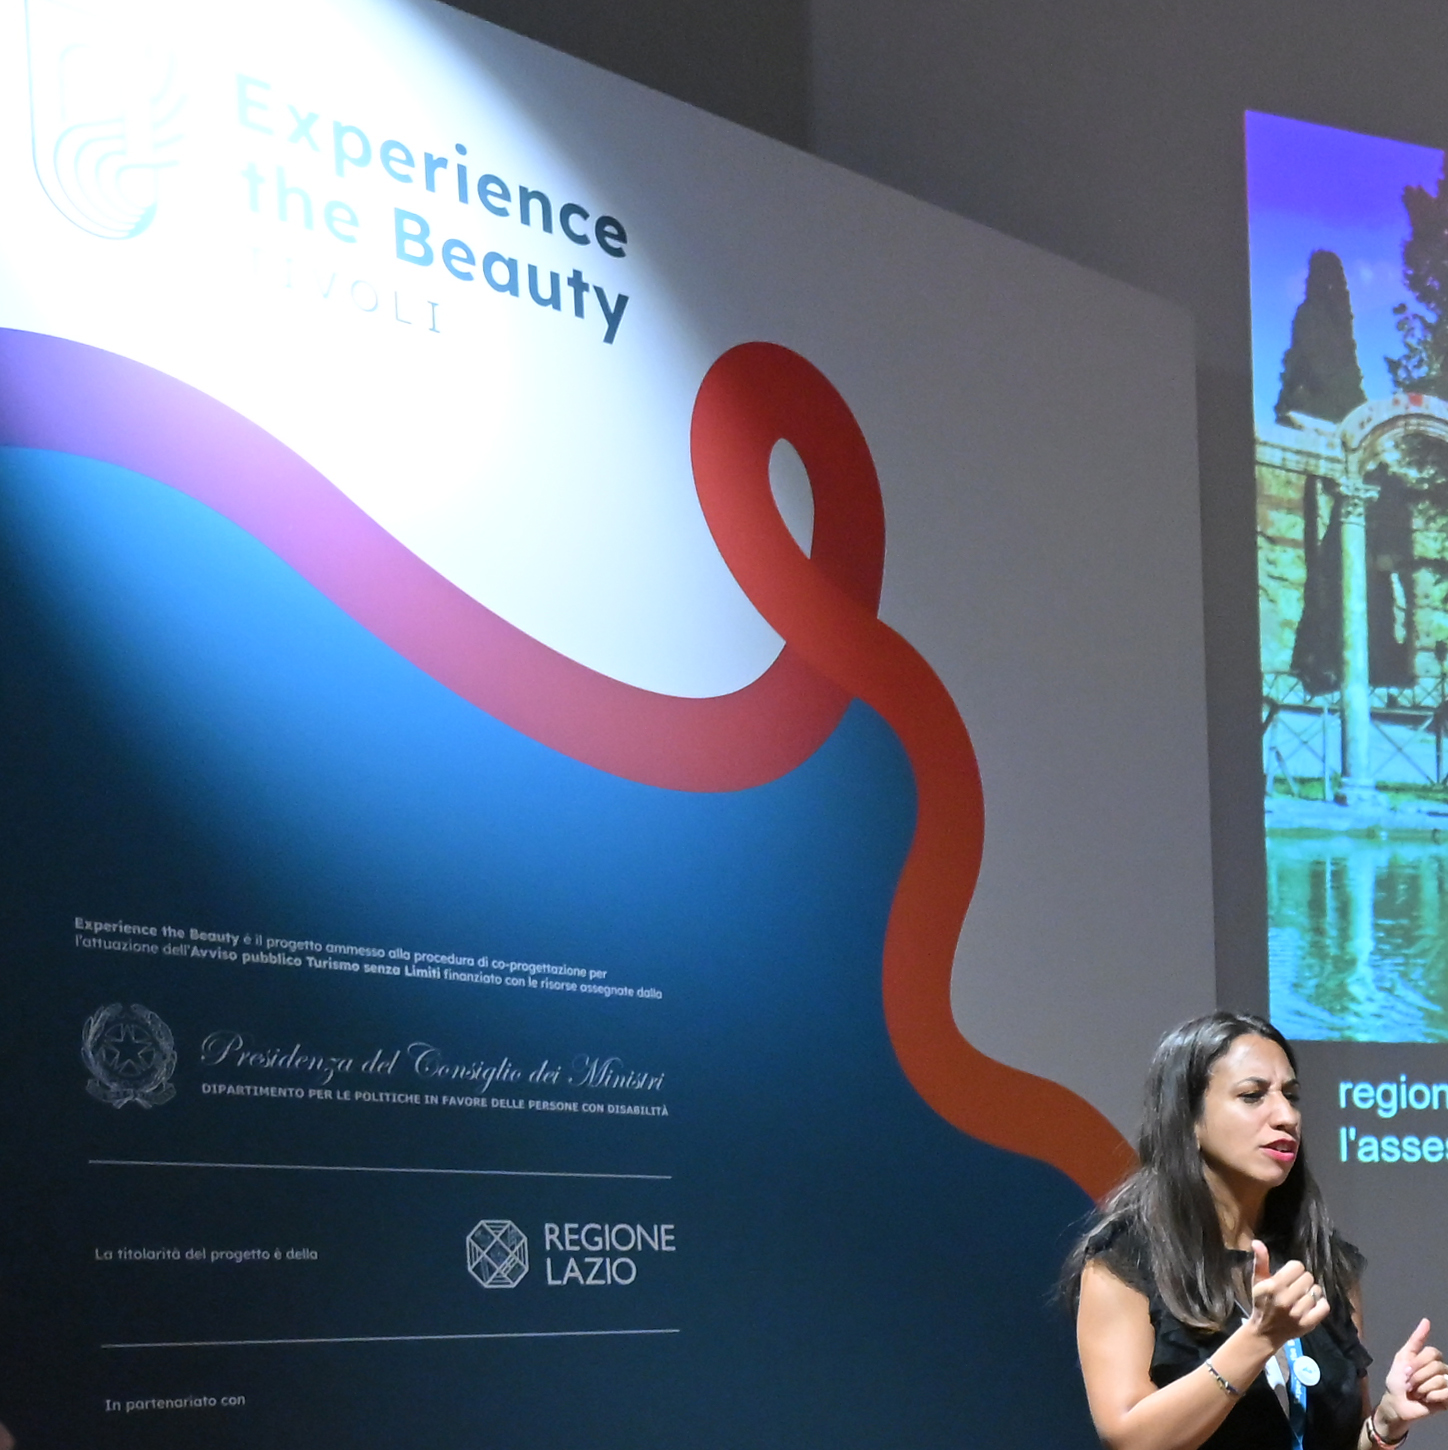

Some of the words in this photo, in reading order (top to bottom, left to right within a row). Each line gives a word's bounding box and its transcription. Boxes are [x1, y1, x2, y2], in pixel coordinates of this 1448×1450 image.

[235, 72, 628, 258] Experience
[240, 161, 360, 244] the
[393, 206, 629, 345] Beauty
[75, 917, 157, 937] Experience
[162, 925, 185, 939] the
[190, 928, 239, 946] Beauty
[255, 935, 263, 946] il
[266, 937, 322, 951] progetto
[326, 943, 385, 958] ammesso
[388, 948, 411, 960] alla
[414, 952, 474, 967] procedura
[477, 956, 489, 967] di
[492, 960, 587, 978] co-progettazione
[589, 968, 607, 980] per
[76, 934, 159, 954] l'attuazione
[163, 942, 238, 961] dell'Avviso
[242, 950, 301, 966] pubblico
[306, 956, 360, 972] Turismo
[363, 962, 400, 976] senza
[405, 964, 441, 980] Limiti
[443, 967, 502, 984] finanziato
[505, 977, 525, 987] con
[528, 977, 537, 988] le
[541, 978, 577, 991] risorse
[580, 983, 634, 997] assegnate
[637, 987, 662, 999] dalla
[201, 1030, 353, 1086] Presidenza
[361, 1049, 401, 1075] del
[407, 1041, 521, 1093] Consiglio
[528, 1060, 562, 1084] dei
[568, 1054, 665, 1090] Ministri
[202, 1083, 304, 1099] DIPARTIMENTO
[308, 1089, 333, 1100] PER
[336, 1089, 350, 1100] LE
[355, 1091, 420, 1105] POLITICHE
[425, 1095, 438, 1105] IN
[442, 1095, 487, 1107] FAVORE
[491, 1098, 525, 1109] DELLE
[528, 1100, 579, 1112] PERSONE
[582, 1102, 604, 1113] CON
[608, 1104, 669, 1116] DISABILITÀ
[95, 1248, 113, 1261] La
[118, 1247, 180, 1261] titolarità
[185, 1247, 206, 1260] del
[211, 1248, 270, 1263] progetto
[274, 1246, 282, 1260] è
[286, 1247, 318, 1260] della
[544, 1223, 676, 1251] REGIONE
[547, 1257, 637, 1286] LAZIO
[105, 1399, 121, 1412] In
[126, 1396, 217, 1413] partenariato
[221, 1394, 246, 1406] con
